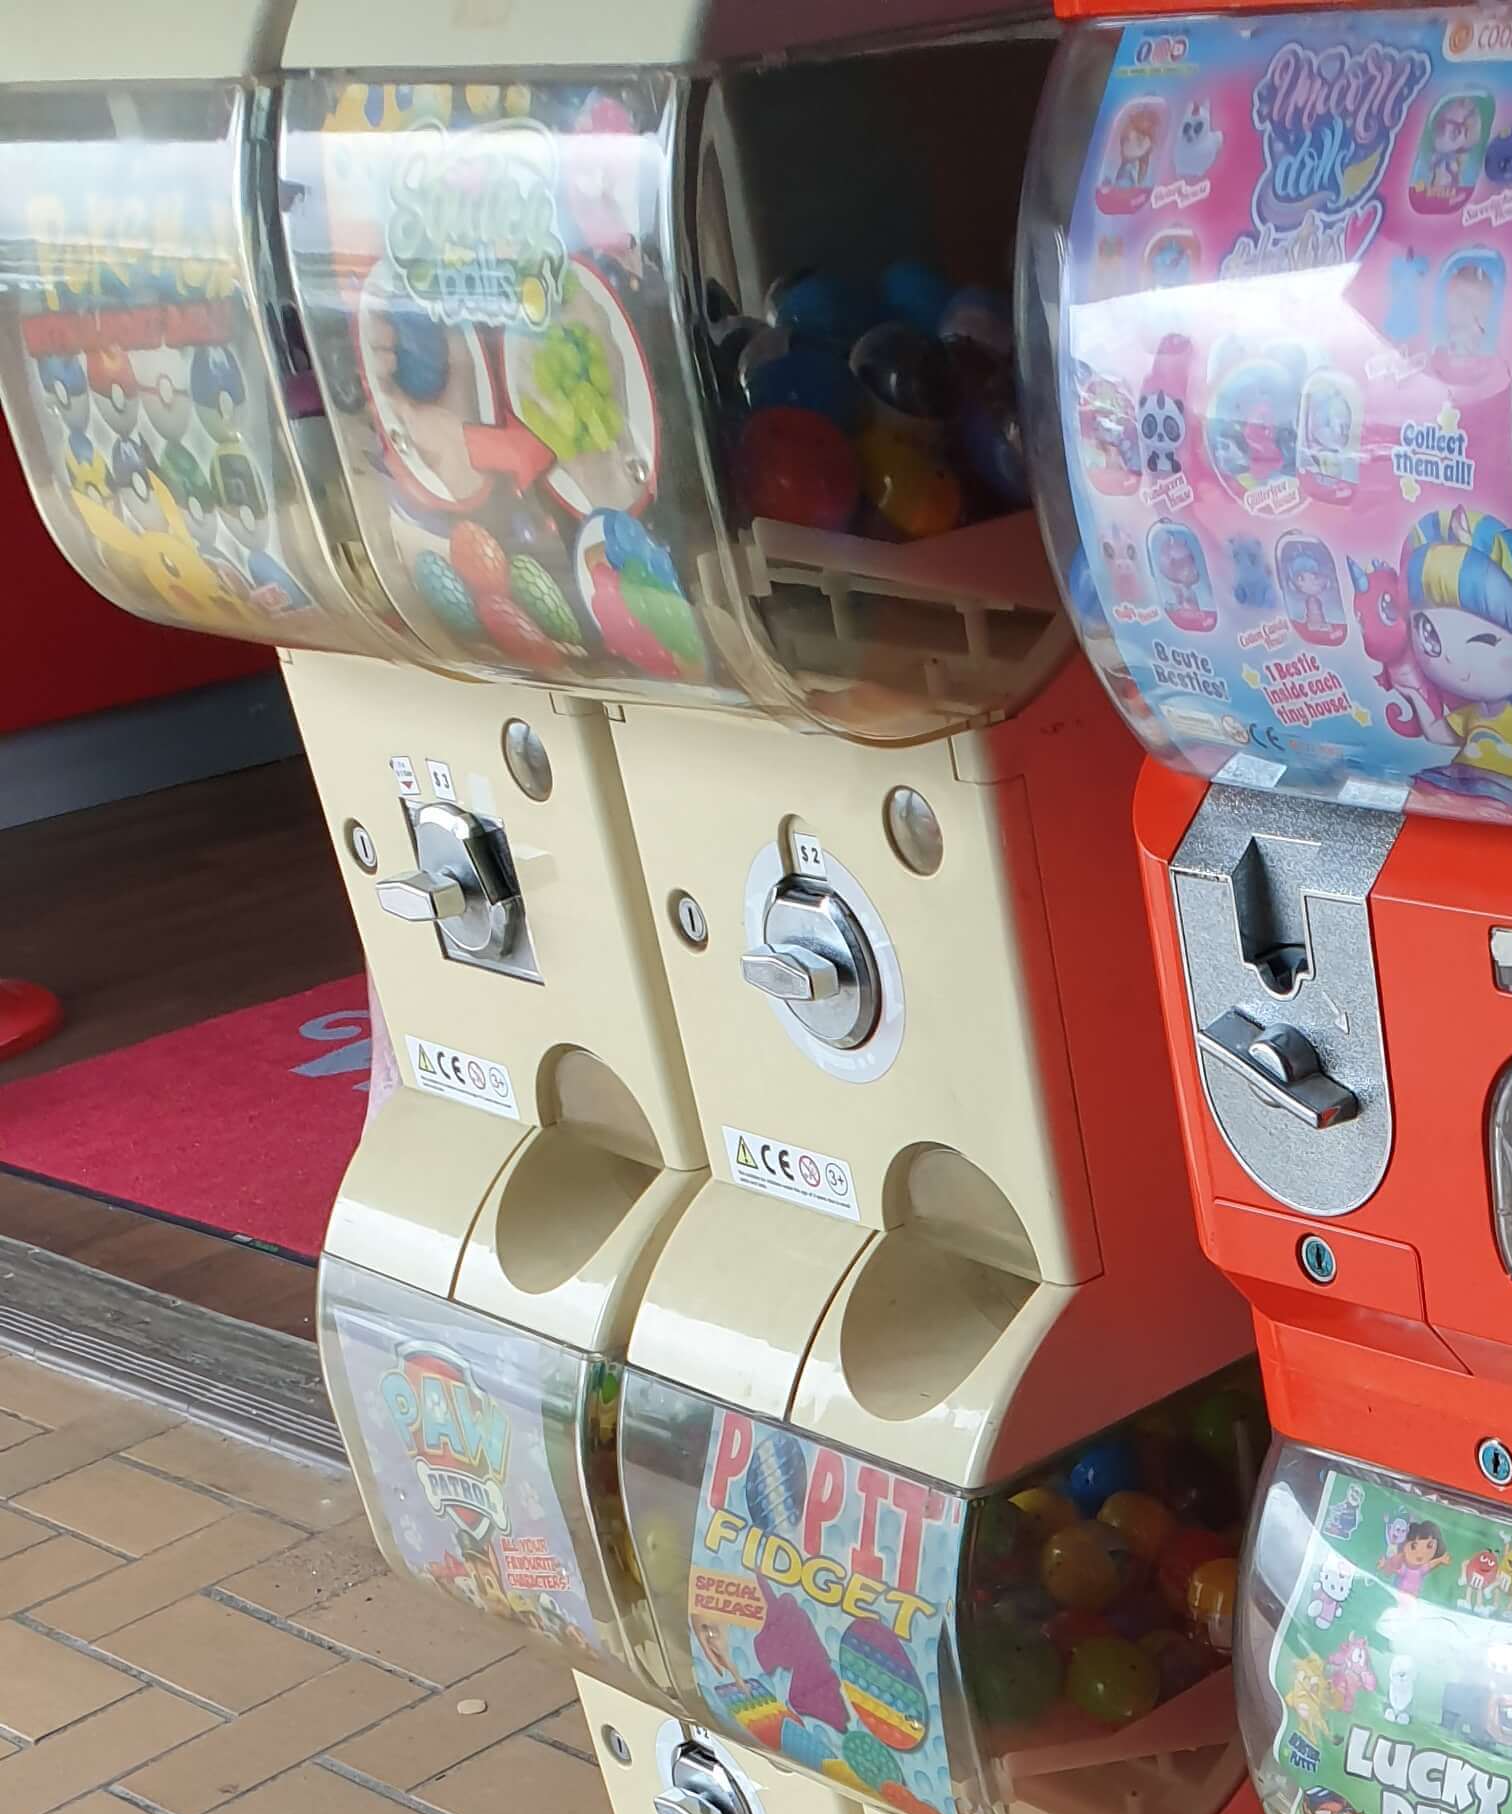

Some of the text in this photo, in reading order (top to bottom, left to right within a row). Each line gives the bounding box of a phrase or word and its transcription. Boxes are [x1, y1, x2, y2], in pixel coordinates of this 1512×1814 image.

[1402, 423, 1466, 457] Collect
[1394, 452, 1473, 487] them all!
[1154, 641, 1212, 675] 8 cute
[1264, 652, 1321, 682] 1 Bestie
[1154, 664, 1230, 700] Besties!
[1308, 673, 1342, 694] each
[1276, 691, 1353, 725] tiny house!
[436, 1051, 467, 1086] CE
[760, 1144, 845, 1187] CE 3+
[378, 1369, 512, 1487] PAW
[426, 1472, 498, 1516] PATROL
[851, 1464, 946, 1597] IT
[695, 1575, 762, 1603] SPECIAL
[704, 1508, 938, 1642] FIDGET
[694, 1594, 765, 1621] RELEASE
